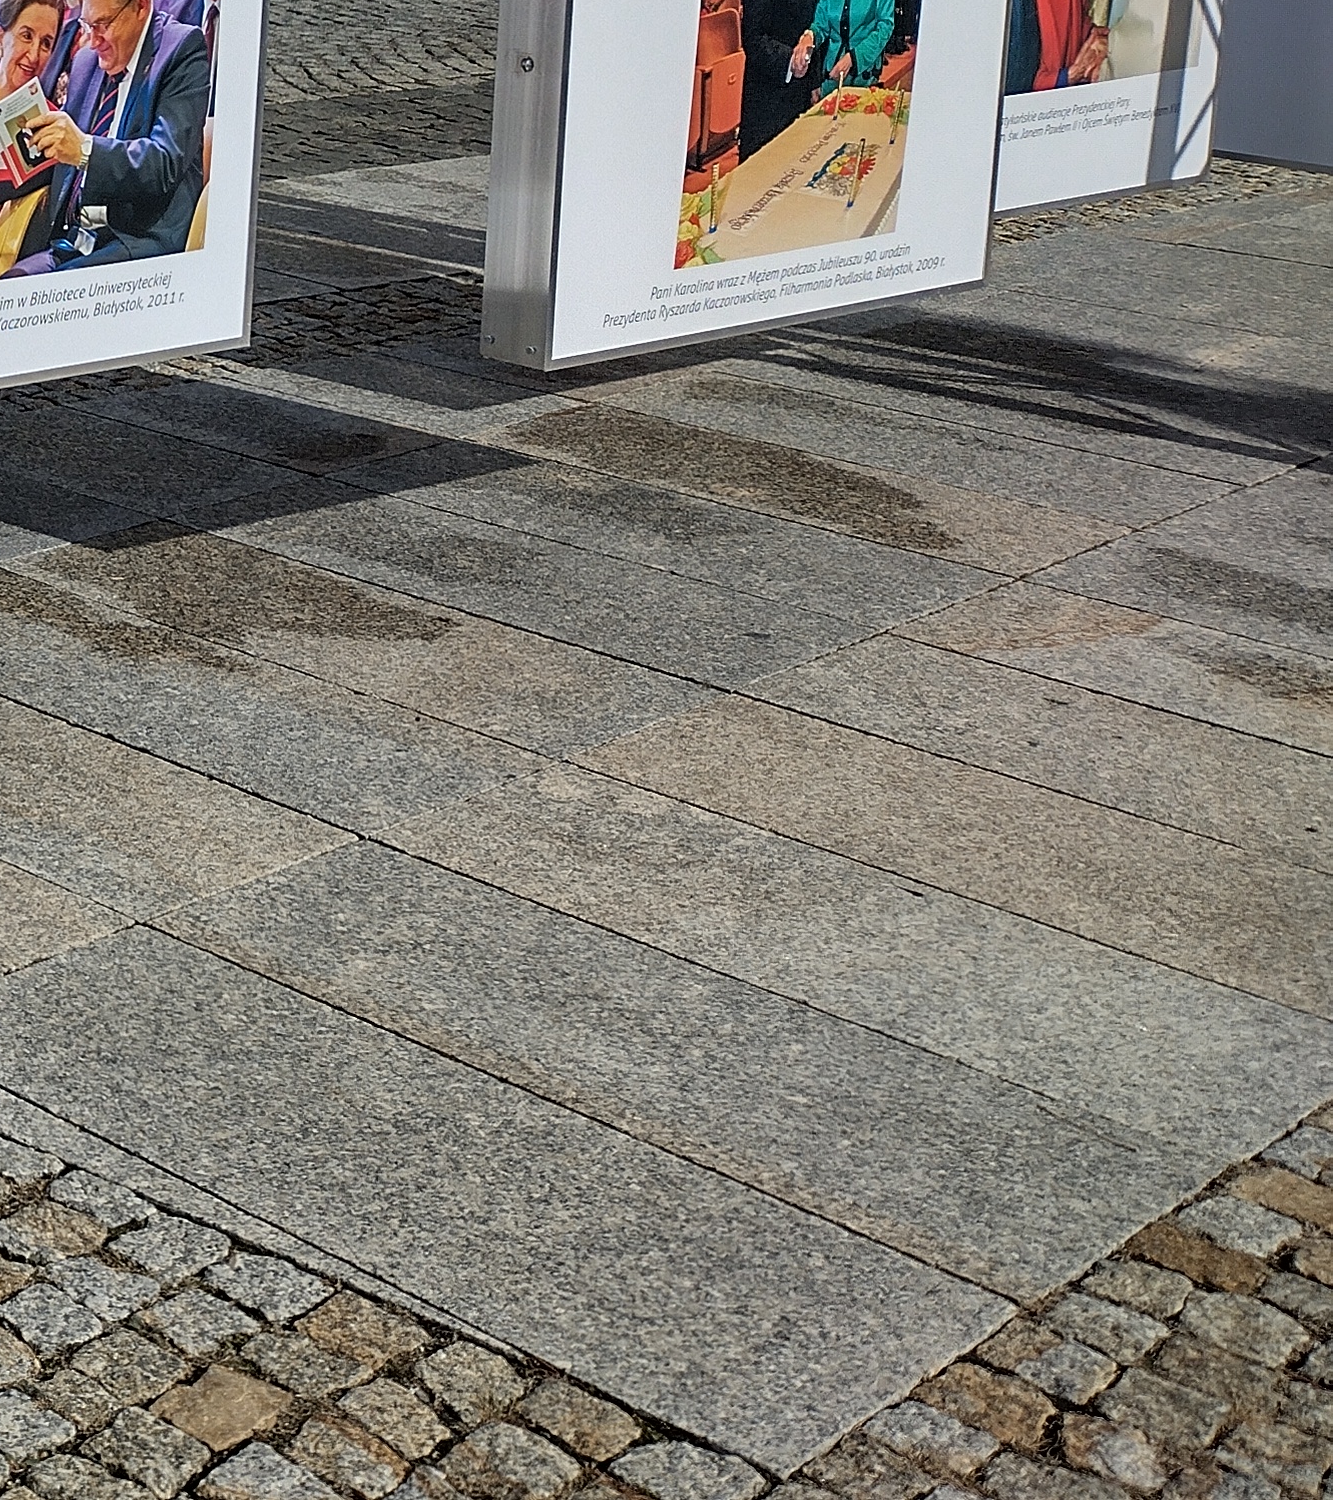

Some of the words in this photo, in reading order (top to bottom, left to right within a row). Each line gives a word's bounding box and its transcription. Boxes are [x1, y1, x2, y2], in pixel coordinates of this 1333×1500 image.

[17, 296, 28, 308] w
[29, 288, 86, 307] Bibliotece
[88, 273, 172, 298] Uniwersyteckiej
[93, 296, 144, 318] Białystok,
[147, 292, 176, 308] 2011
[179, 292, 185, 302] r.
